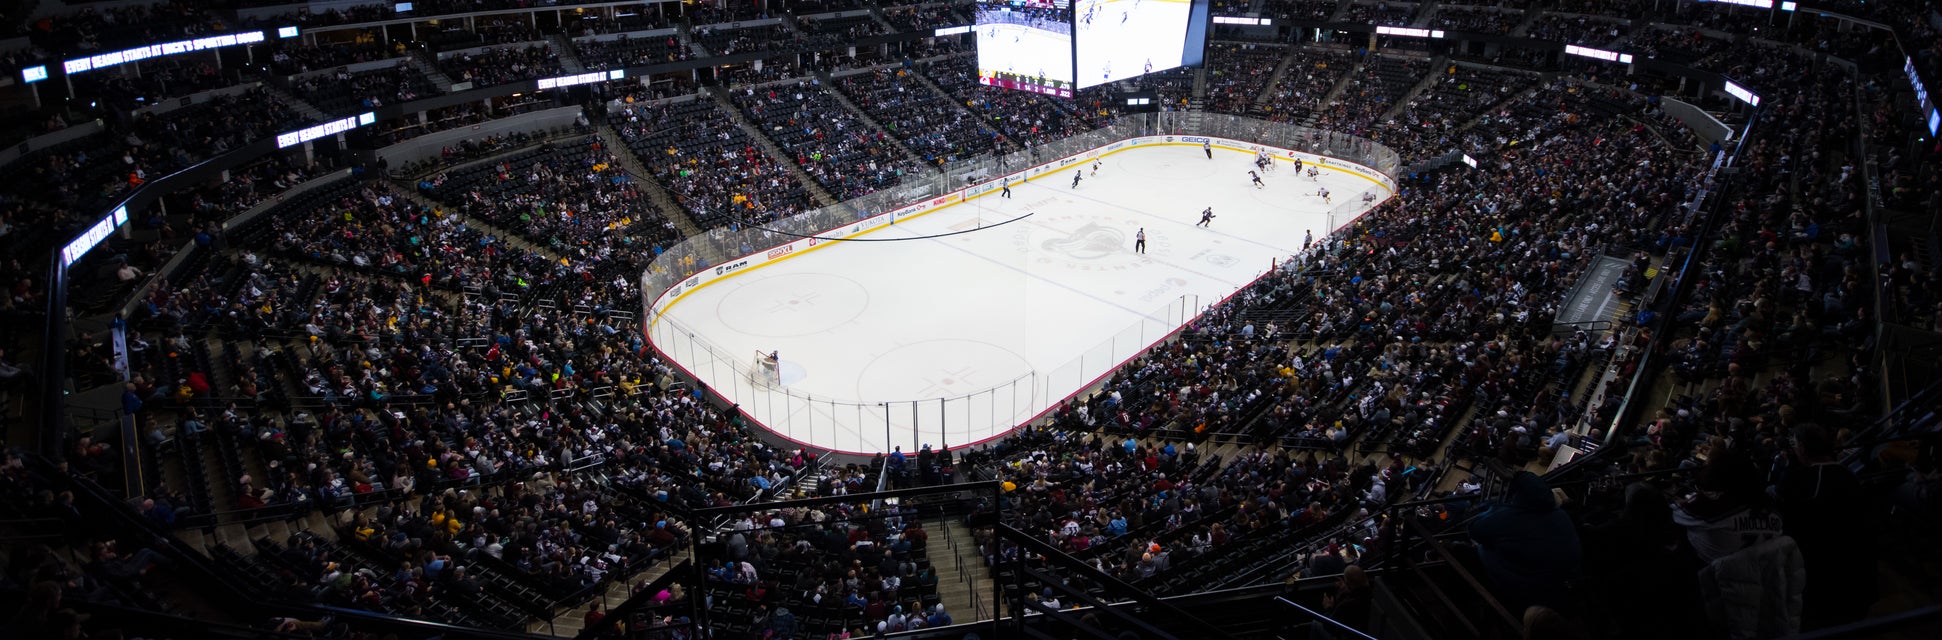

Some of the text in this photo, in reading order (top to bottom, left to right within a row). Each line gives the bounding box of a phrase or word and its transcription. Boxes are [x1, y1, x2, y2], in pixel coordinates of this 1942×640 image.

[64, 57, 92, 74] EVERY
[91, 51, 124, 69] SEASON
[122, 46, 152, 62] STARTS
[150, 44, 162, 57] AT
[192, 34, 237, 50] SPORTING
[236, 31, 264, 44] GOODS
[537, 77, 556, 90] EVERY
[556, 74, 579, 87] SEASON
[578, 72, 600, 84] STARTS
[599, 71, 607, 81] AT
[277, 131, 300, 149] EVERY
[299, 124, 326, 142] SEASON
[323, 118, 349, 136] STARTS
[347, 116, 357, 129] AT
[1181, 136, 1211, 144] GEICO
[897, 207, 917, 218] KeyBank
[88, 219, 109, 247] STARTS
[106, 214, 115, 234] AT
[725, 260, 748, 271] RAM
